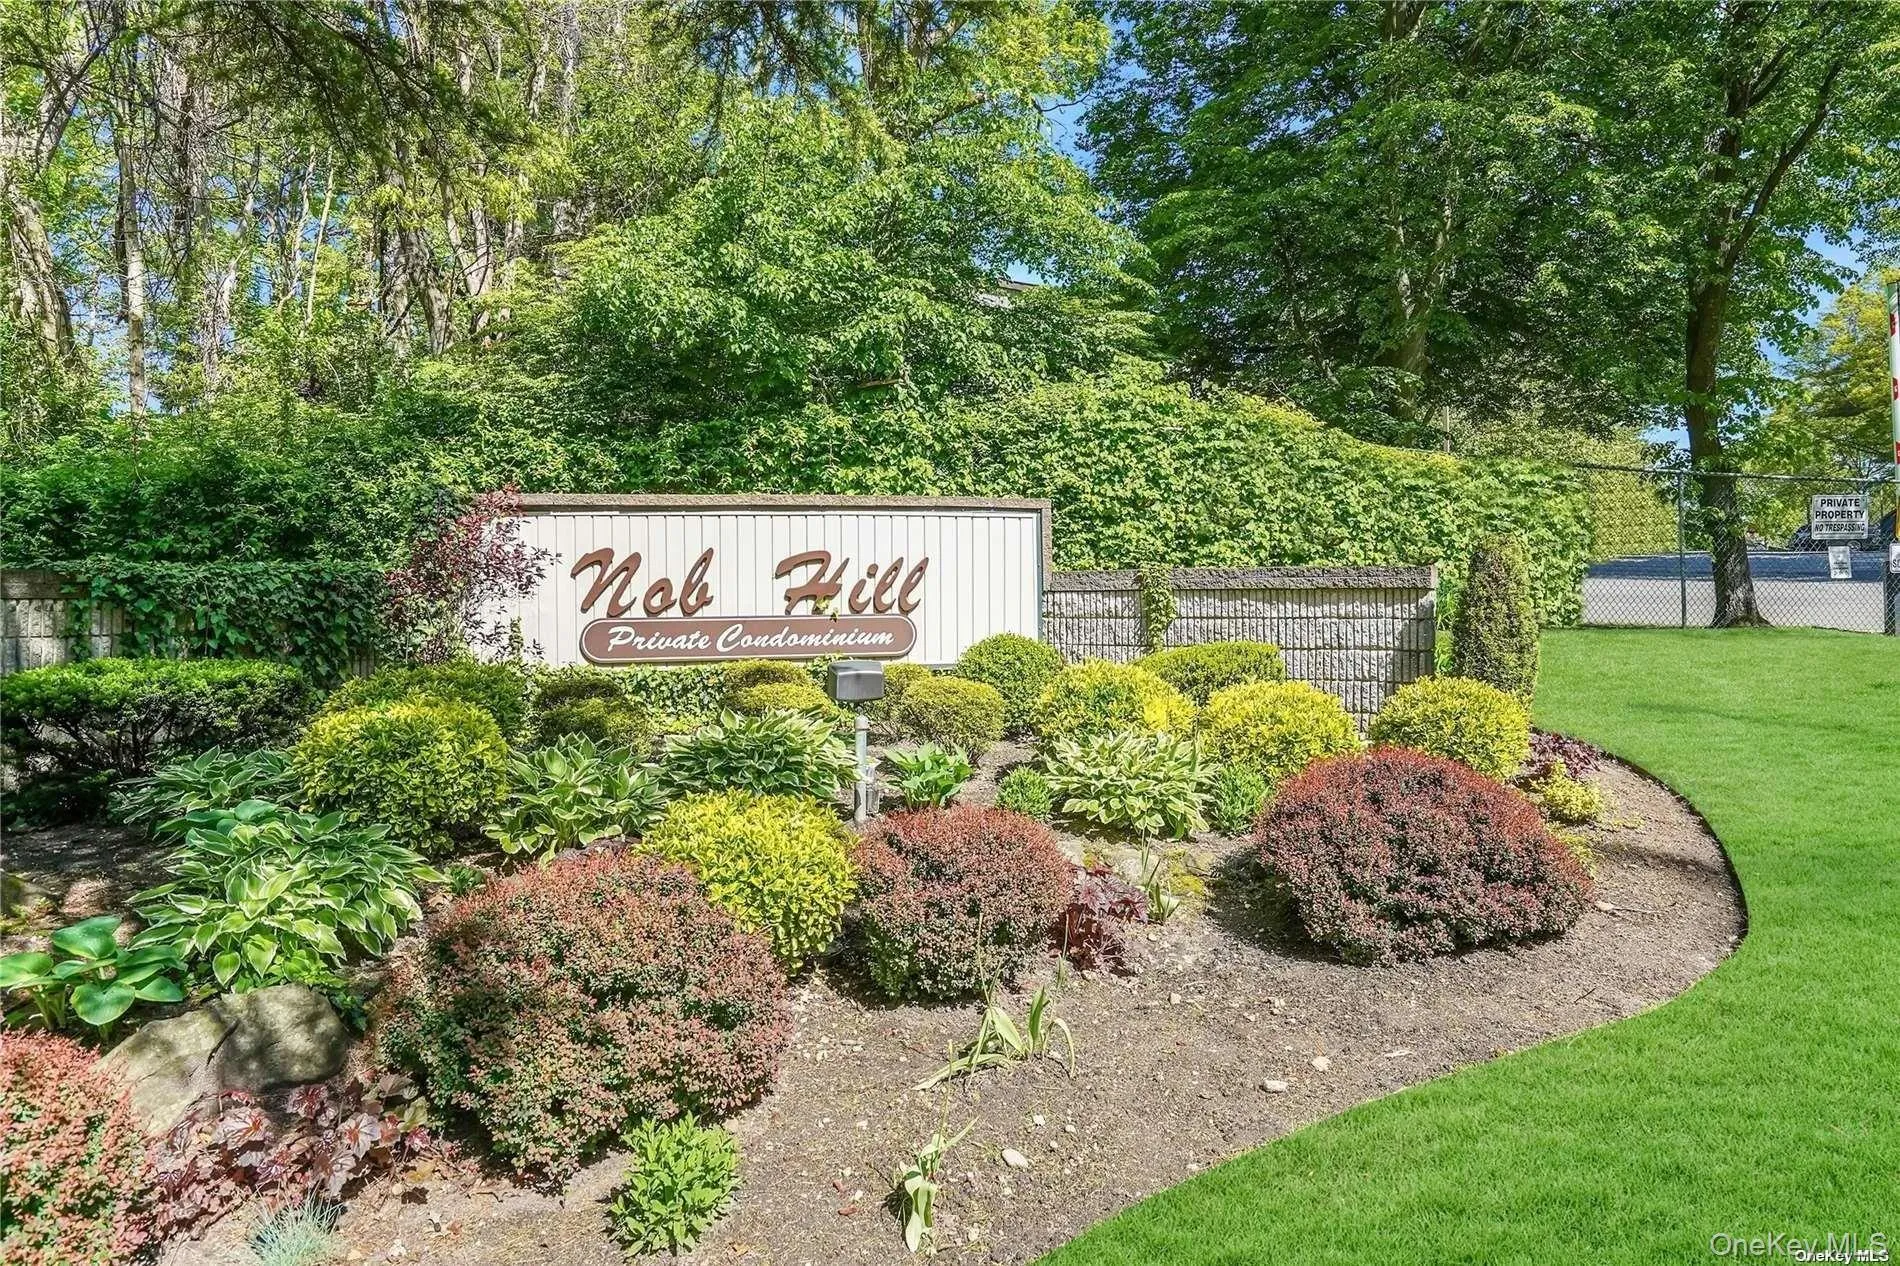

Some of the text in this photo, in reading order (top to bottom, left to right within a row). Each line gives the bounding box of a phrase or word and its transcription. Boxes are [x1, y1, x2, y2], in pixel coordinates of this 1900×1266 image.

[1820, 498, 1860, 507] PRIVATE
[1815, 510, 1865, 519] PROPERTY
[1815, 523, 1824, 532] NO
[570, 547, 929, 618] Nob Hill
[607, 623, 895, 652] Private Condominium
